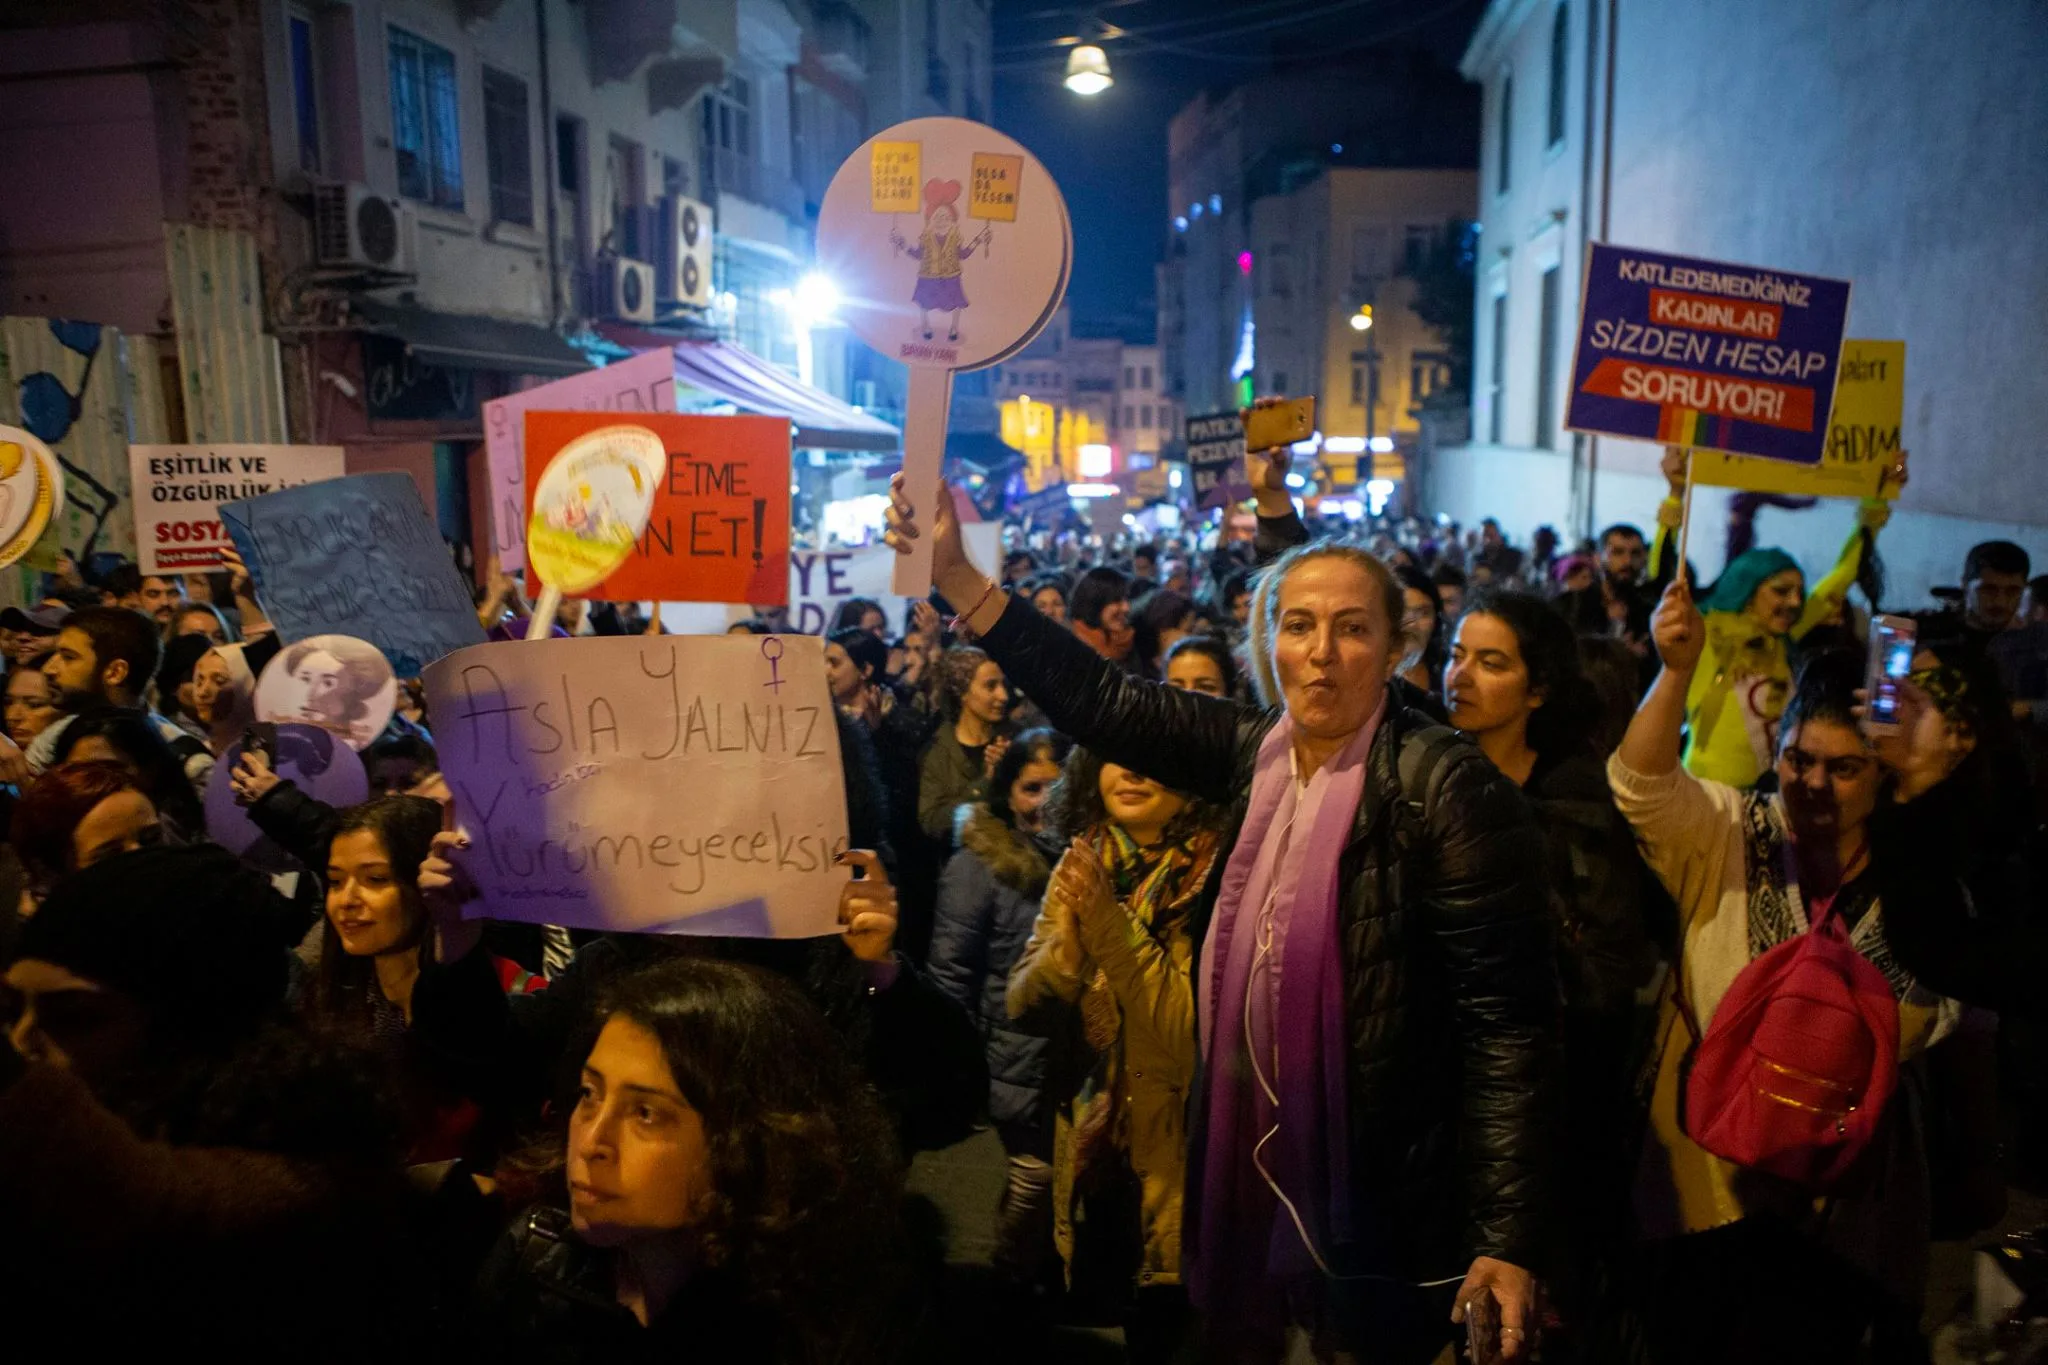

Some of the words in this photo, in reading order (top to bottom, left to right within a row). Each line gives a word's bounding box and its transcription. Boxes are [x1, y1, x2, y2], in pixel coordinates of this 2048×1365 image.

[1619, 259, 1811, 307] KATLEDEMEDİĞİNİZ
[1656, 296, 1776, 336] KADINLAR
[1590, 318, 1711, 364] SİZDEN
[1715, 338, 1827, 380] HESAP
[1620, 366, 1786, 420] SORUYOR!
[150, 452, 232, 480] EŞİTLİK
[239, 457, 267, 473] VE
[669, 453, 752, 496] ETME
